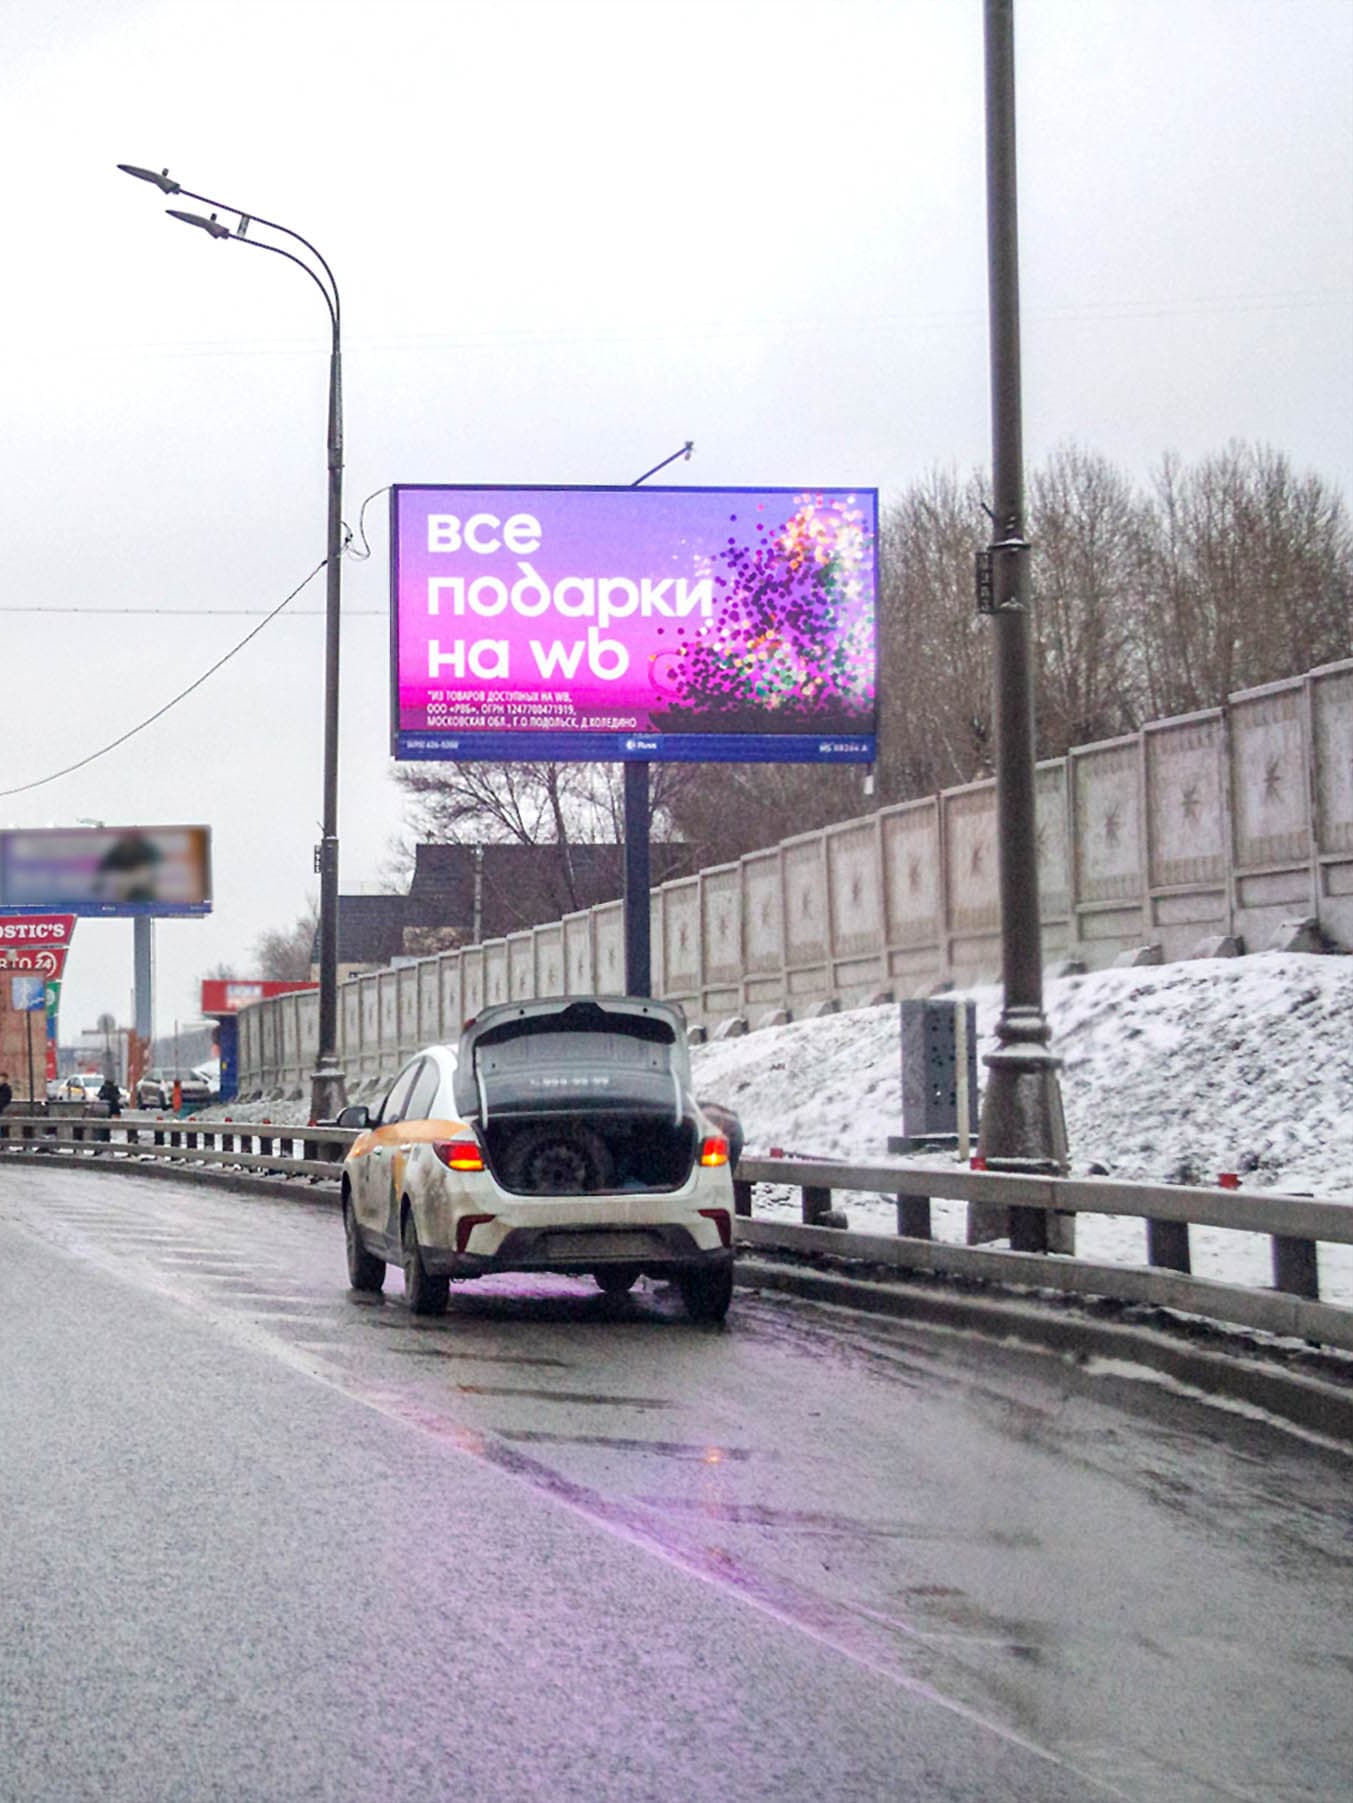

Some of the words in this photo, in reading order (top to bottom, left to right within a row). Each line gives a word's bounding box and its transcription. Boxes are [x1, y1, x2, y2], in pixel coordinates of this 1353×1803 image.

[427, 513, 543, 555] все
[427, 561, 714, 629] подарки
[427, 638, 510, 680] на
[528, 626, 630, 681] wb
[427, 703, 448, 714] ООО
[481, 703, 505, 715] ОГРН
[446, 690, 485, 702] ТОВАРОВ
[487, 690, 539, 703] ДОСТУПНЫХ
[541, 691, 553, 702] НА
[427, 715, 486, 728] МОСКОВСКАЯ
